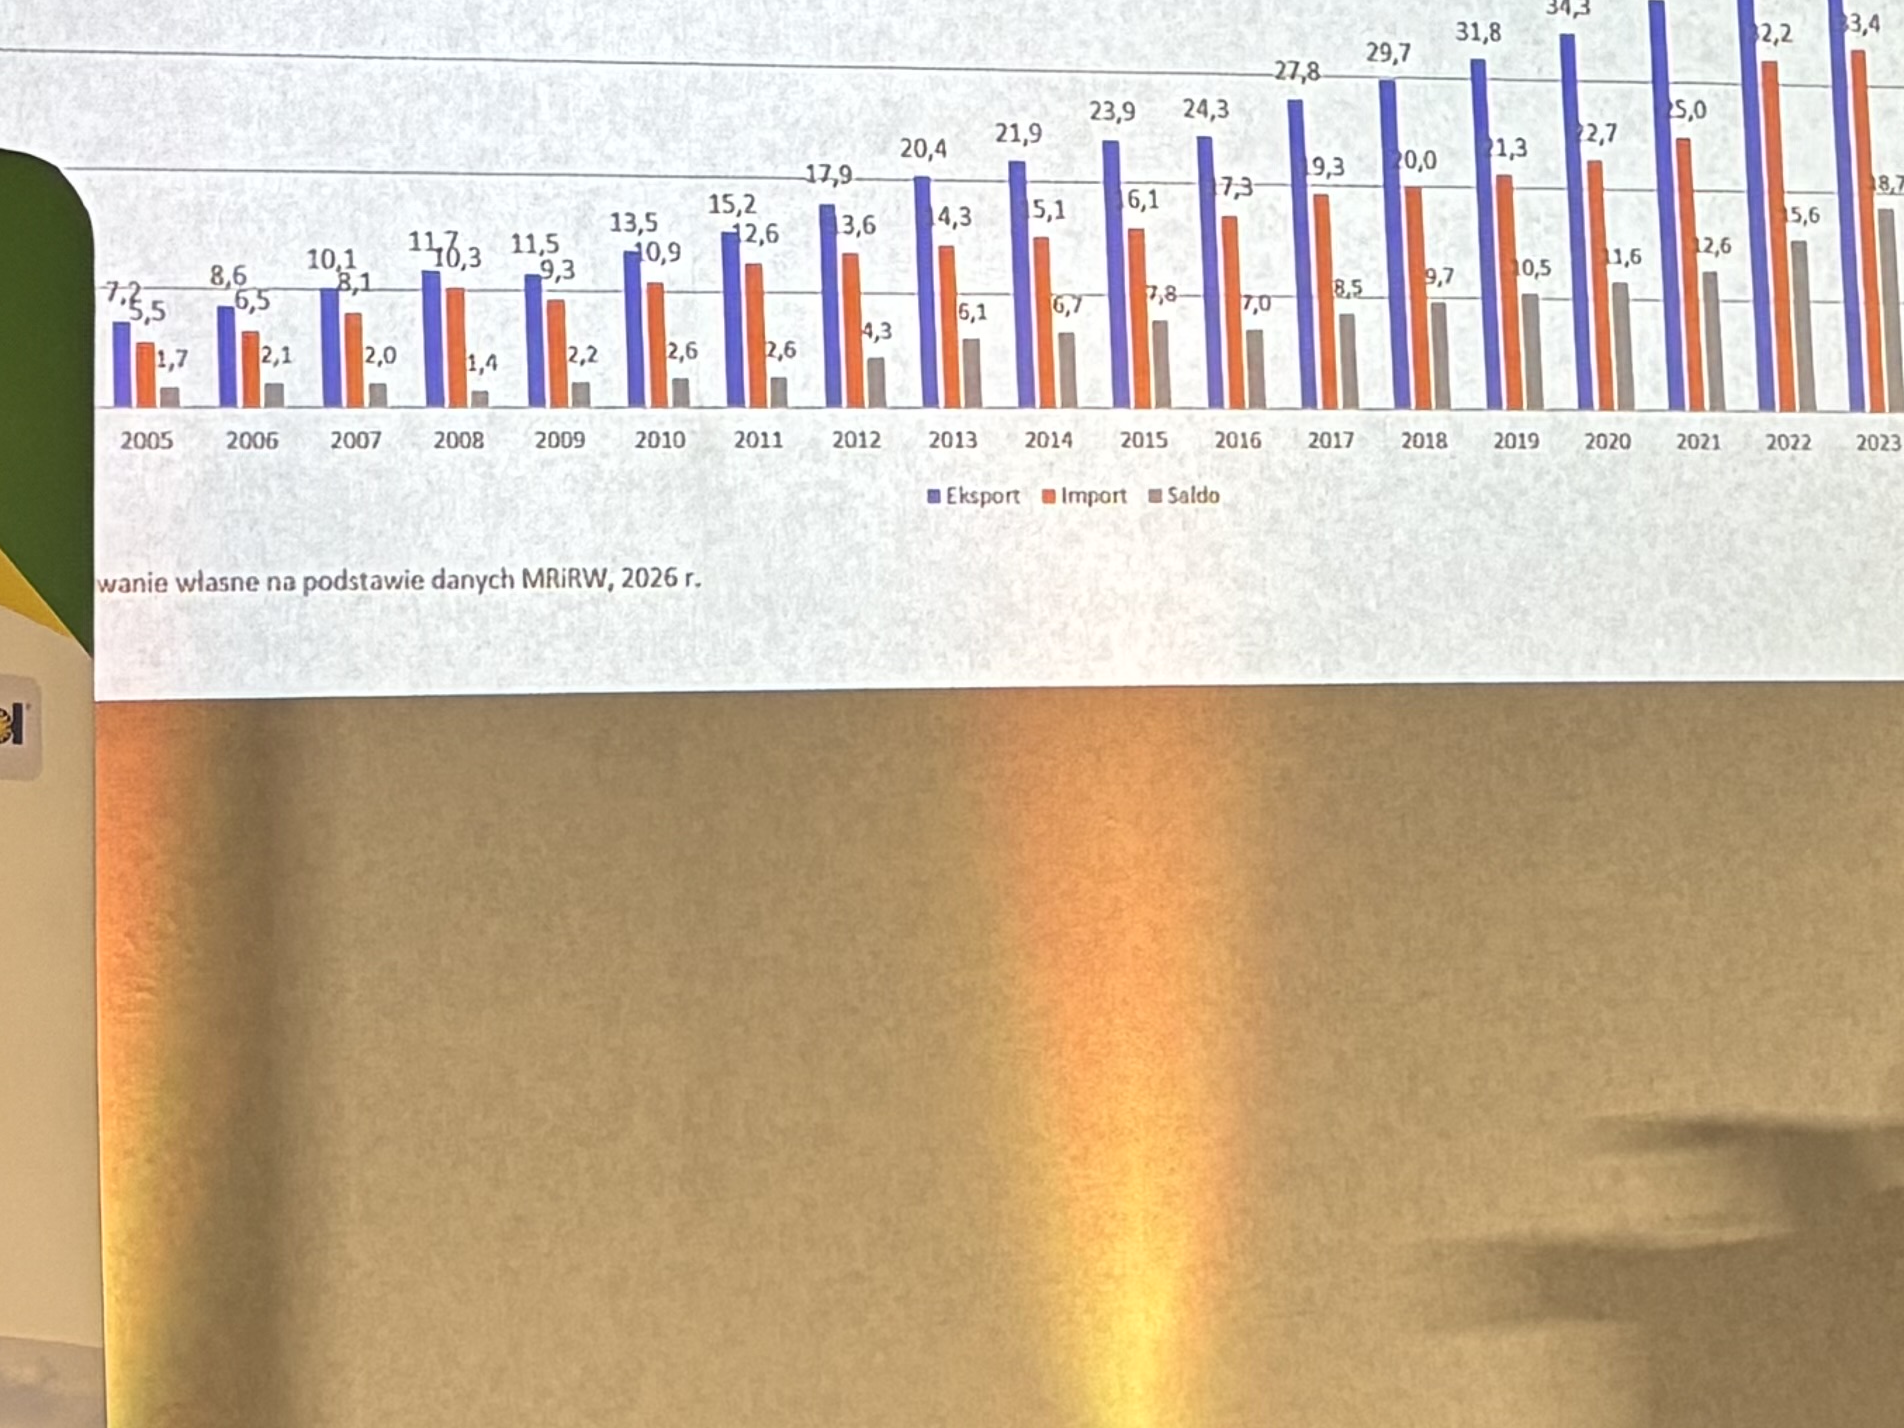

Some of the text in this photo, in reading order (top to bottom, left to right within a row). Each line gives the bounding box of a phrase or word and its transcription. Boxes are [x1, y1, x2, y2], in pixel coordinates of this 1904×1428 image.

[1456, 22, 1501, 44] 31,8
[1367, 42, 1411, 64] 29,7
[1274, 61, 1321, 84] 27,8
[1089, 101, 1136, 126] 23,9
[1183, 98, 1229, 121] 24,3
[995, 123, 1043, 147] 21,9
[900, 138, 947, 162] 20,4
[805, 165, 853, 189] 17,9
[708, 194, 757, 218] 15,2
[610, 212, 659, 236] 13,5
[512, 233, 559, 257] 11,5
[307, 249, 357, 273] 10,1
[540, 259, 575, 283] 9,3
[210, 265, 247, 290] 8,6
[235, 290, 270, 315] 6,5
[1052, 295, 1083, 317] 6,7
[157, 349, 188, 372] 1,7
[261, 345, 292, 368] 2,1
[364, 345, 397, 368] 2,0
[467, 353, 498, 375] 1,4
[567, 346, 598, 368] 2,2
[120, 430, 174, 450] 2005
[226, 430, 279, 450] 2006
[330, 430, 382, 450] 2007
[433, 430, 485, 450] 2008
[534, 430, 586, 450] 2009
[634, 430, 686, 450] 2010
[734, 430, 784, 450] 2011
[832, 430, 882, 450] 2012
[928, 430, 978, 450] 2013
[1025, 430, 1073, 450] 2014
[1120, 430, 1169, 450] 2015
[1215, 430, 1262, 450] 2016
[1308, 430, 1354, 450] 2017
[1401, 430, 1448, 450] 2018
[1494, 430, 1539, 450] 2019
[1585, 431, 1632, 452] 2020
[1676, 431, 1722, 452] 2021
[1766, 431, 1812, 452] 2022
[1856, 431, 1902, 452] 2023
[946, 485, 1221, 510] Eksport Import Saldo
[176, 570, 260, 593] własne
[267, 575, 296, 593] na
[303, 569, 425, 596] podstawie
[432, 568, 514, 595] danych
[622, 569, 678, 590] 2026
[686, 572, 702, 589] r.
